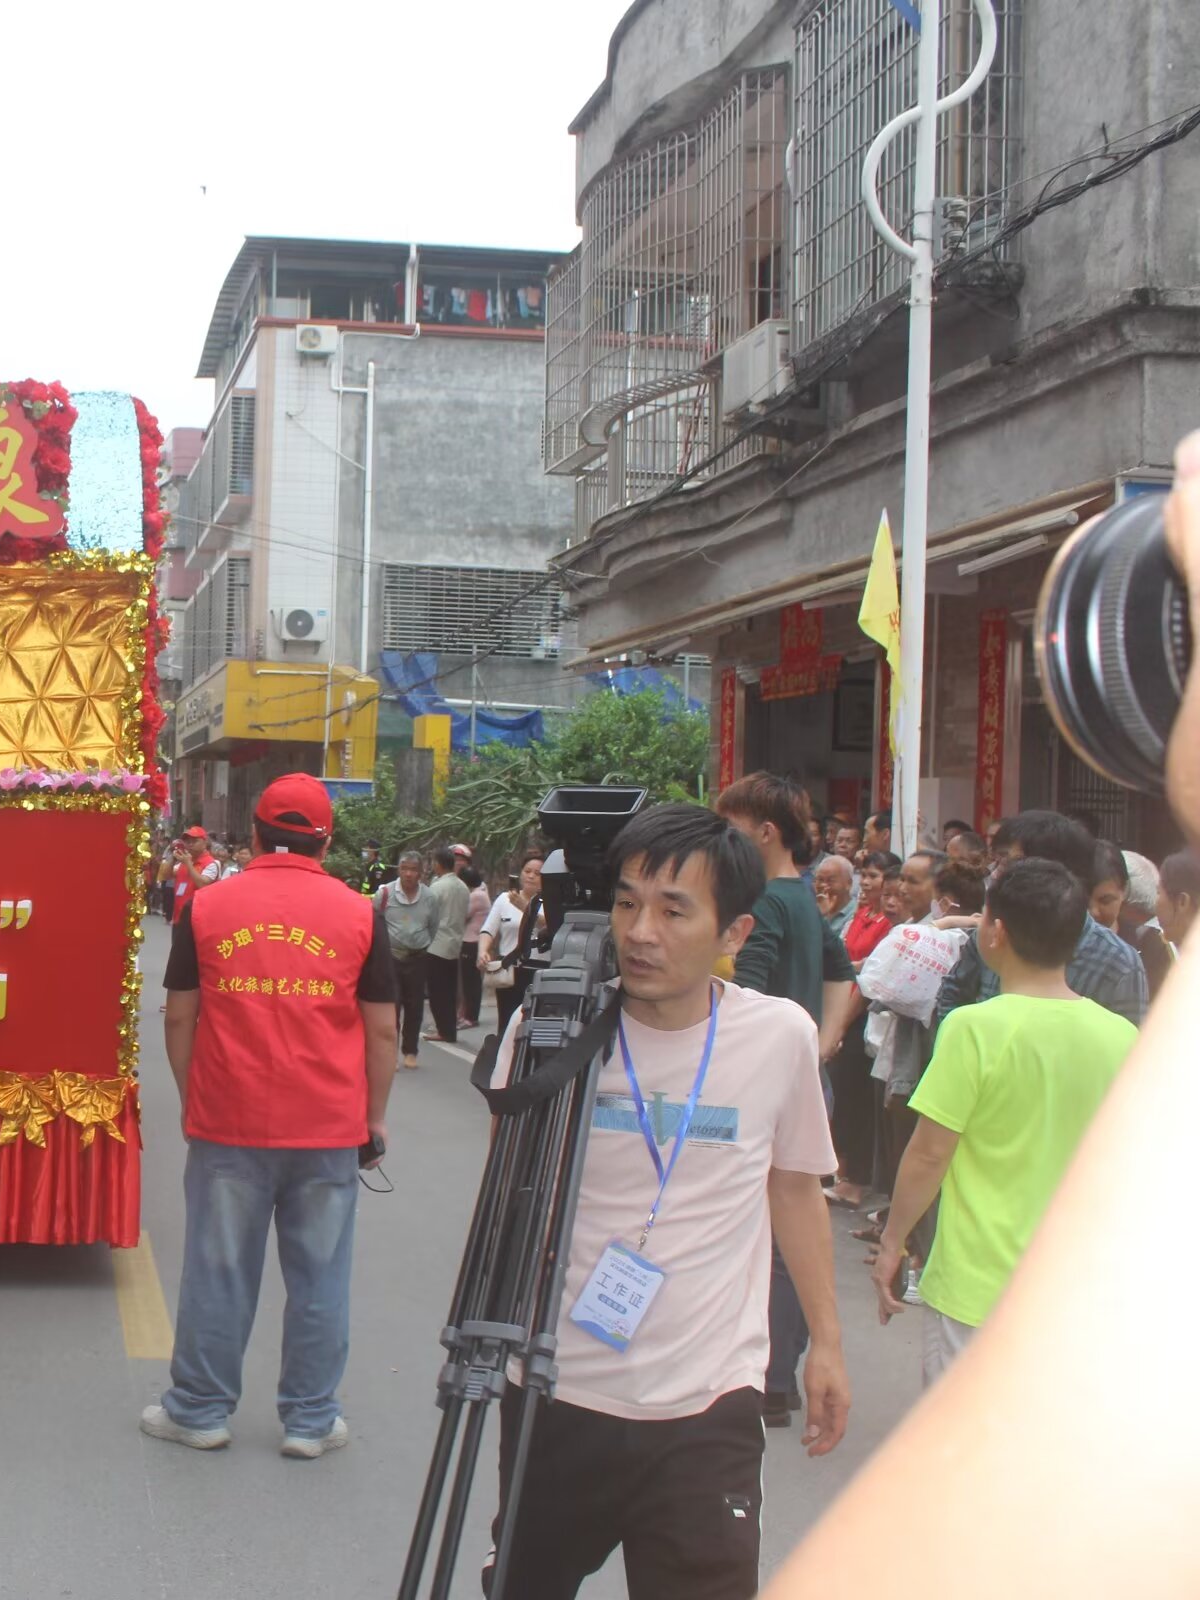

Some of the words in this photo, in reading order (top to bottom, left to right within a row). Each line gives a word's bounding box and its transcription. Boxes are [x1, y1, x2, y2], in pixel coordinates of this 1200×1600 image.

[217, 923, 337, 959] 沙琅“三月三”
[217, 976, 335, 996] 文化旅游艺术活动
[596, 1271, 645, 1310] 工作证
